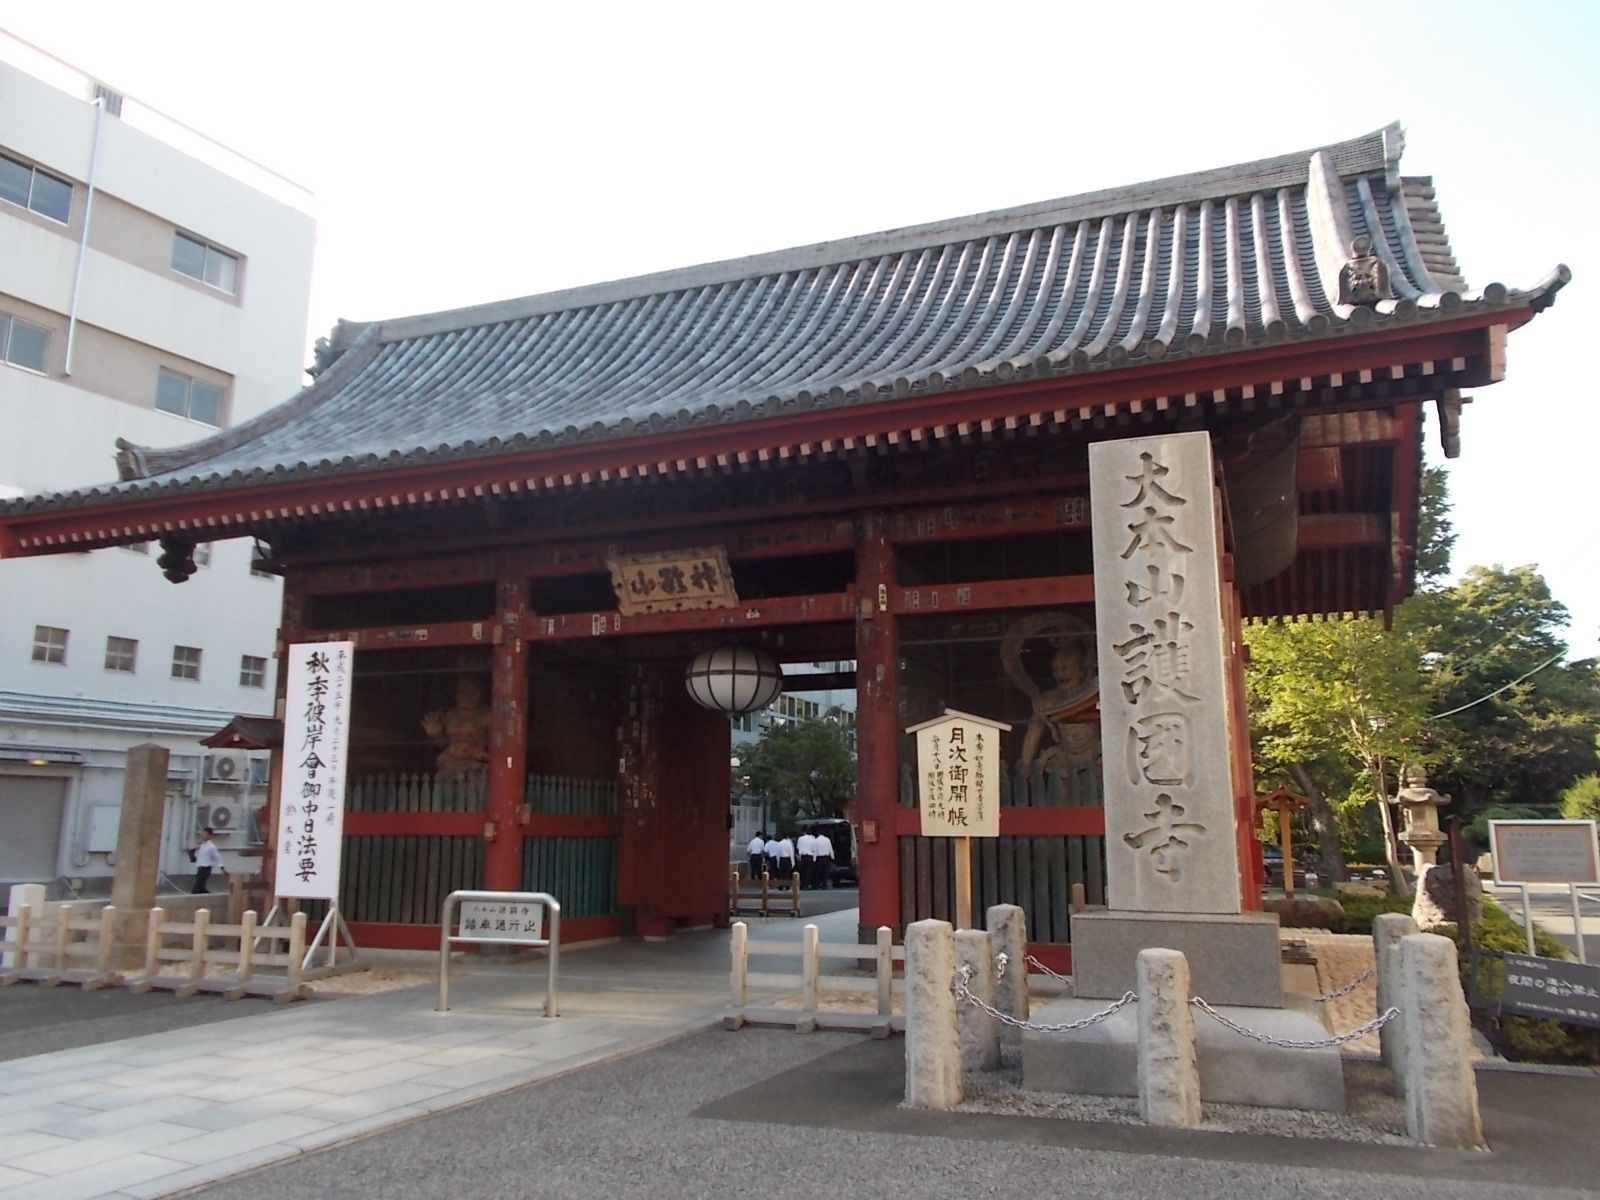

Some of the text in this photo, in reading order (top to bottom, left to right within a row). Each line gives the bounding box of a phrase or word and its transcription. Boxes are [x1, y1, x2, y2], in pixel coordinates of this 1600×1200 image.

[948, 727, 969, 827] 月次御開帳
